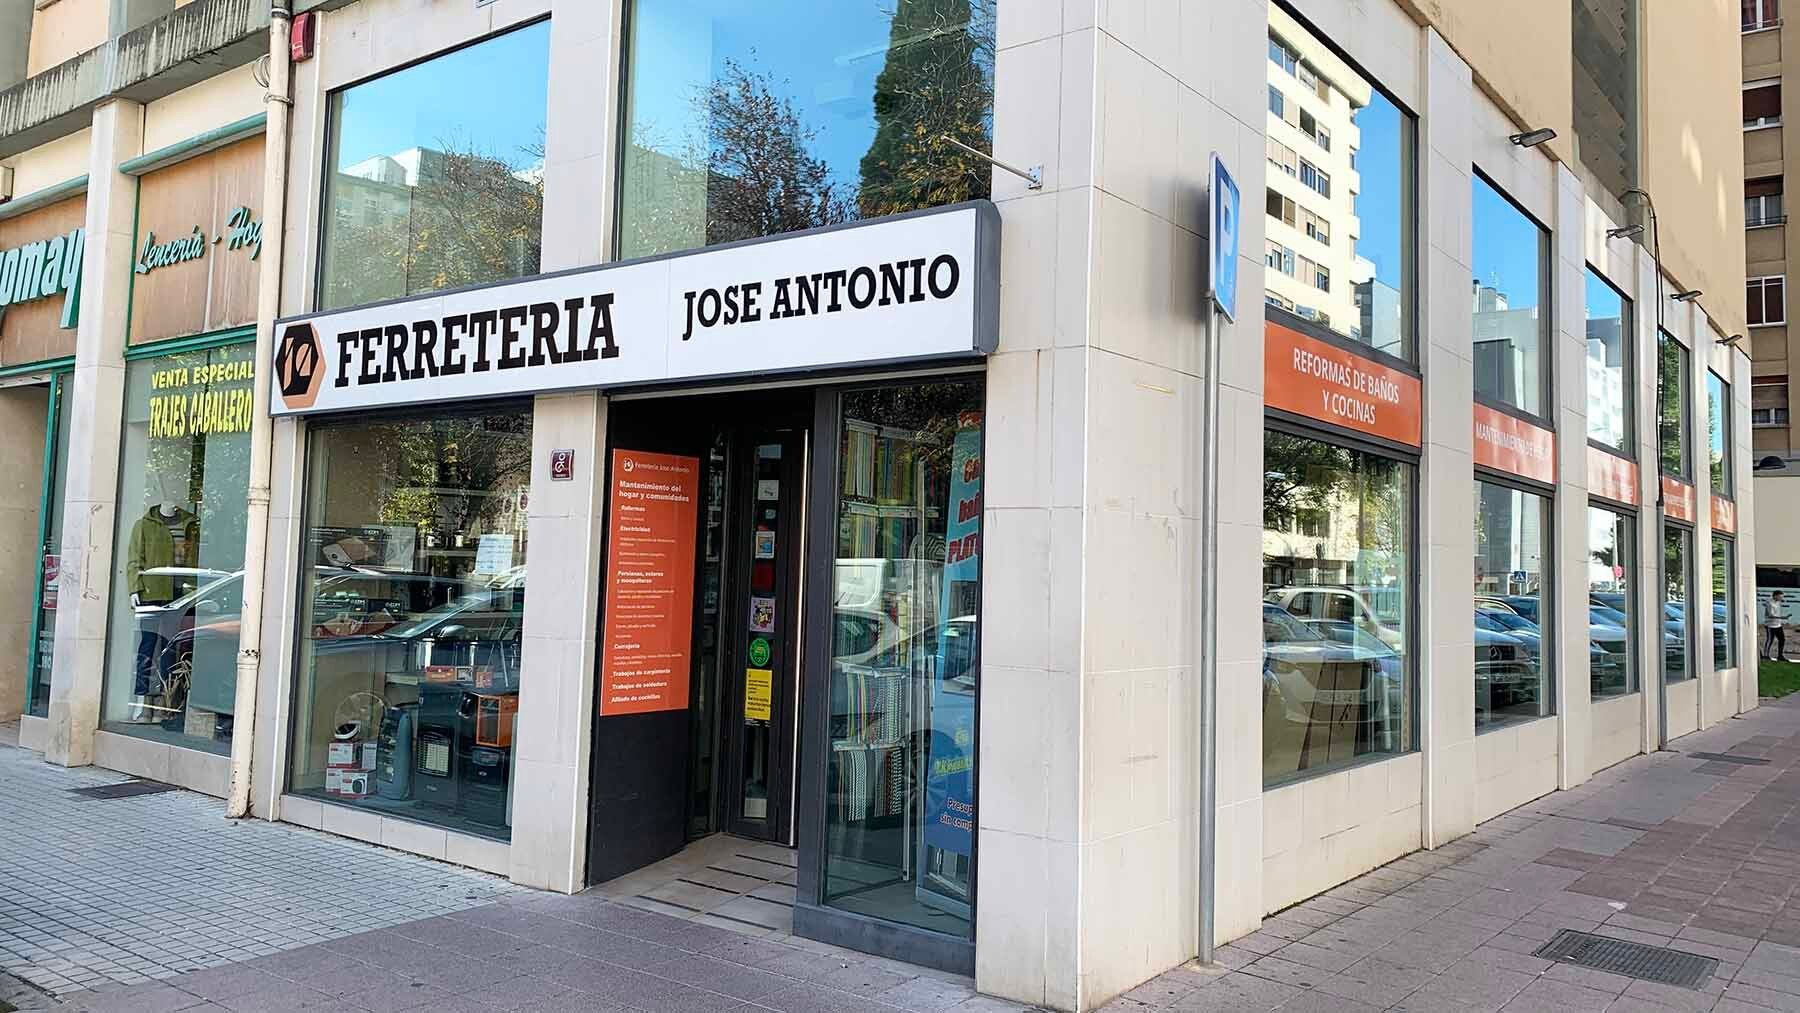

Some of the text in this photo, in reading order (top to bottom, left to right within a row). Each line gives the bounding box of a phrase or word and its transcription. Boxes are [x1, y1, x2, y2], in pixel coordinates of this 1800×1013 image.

[0, 228, 85, 329] omay
[682, 254, 960, 341] JOSE ANTONIO
[334, 292, 620, 388] FERRETERIA
[152, 360, 254, 389] VENTA ESPECIAL
[1293, 347, 1400, 404] REFORMAS DE BAÑOS
[150, 388, 253, 439] TRAJES CABALLERO
[1322, 389, 1377, 425] Y COCINAS
[619, 490, 638, 499] hogar
[646, 493, 689, 502] comunidades
